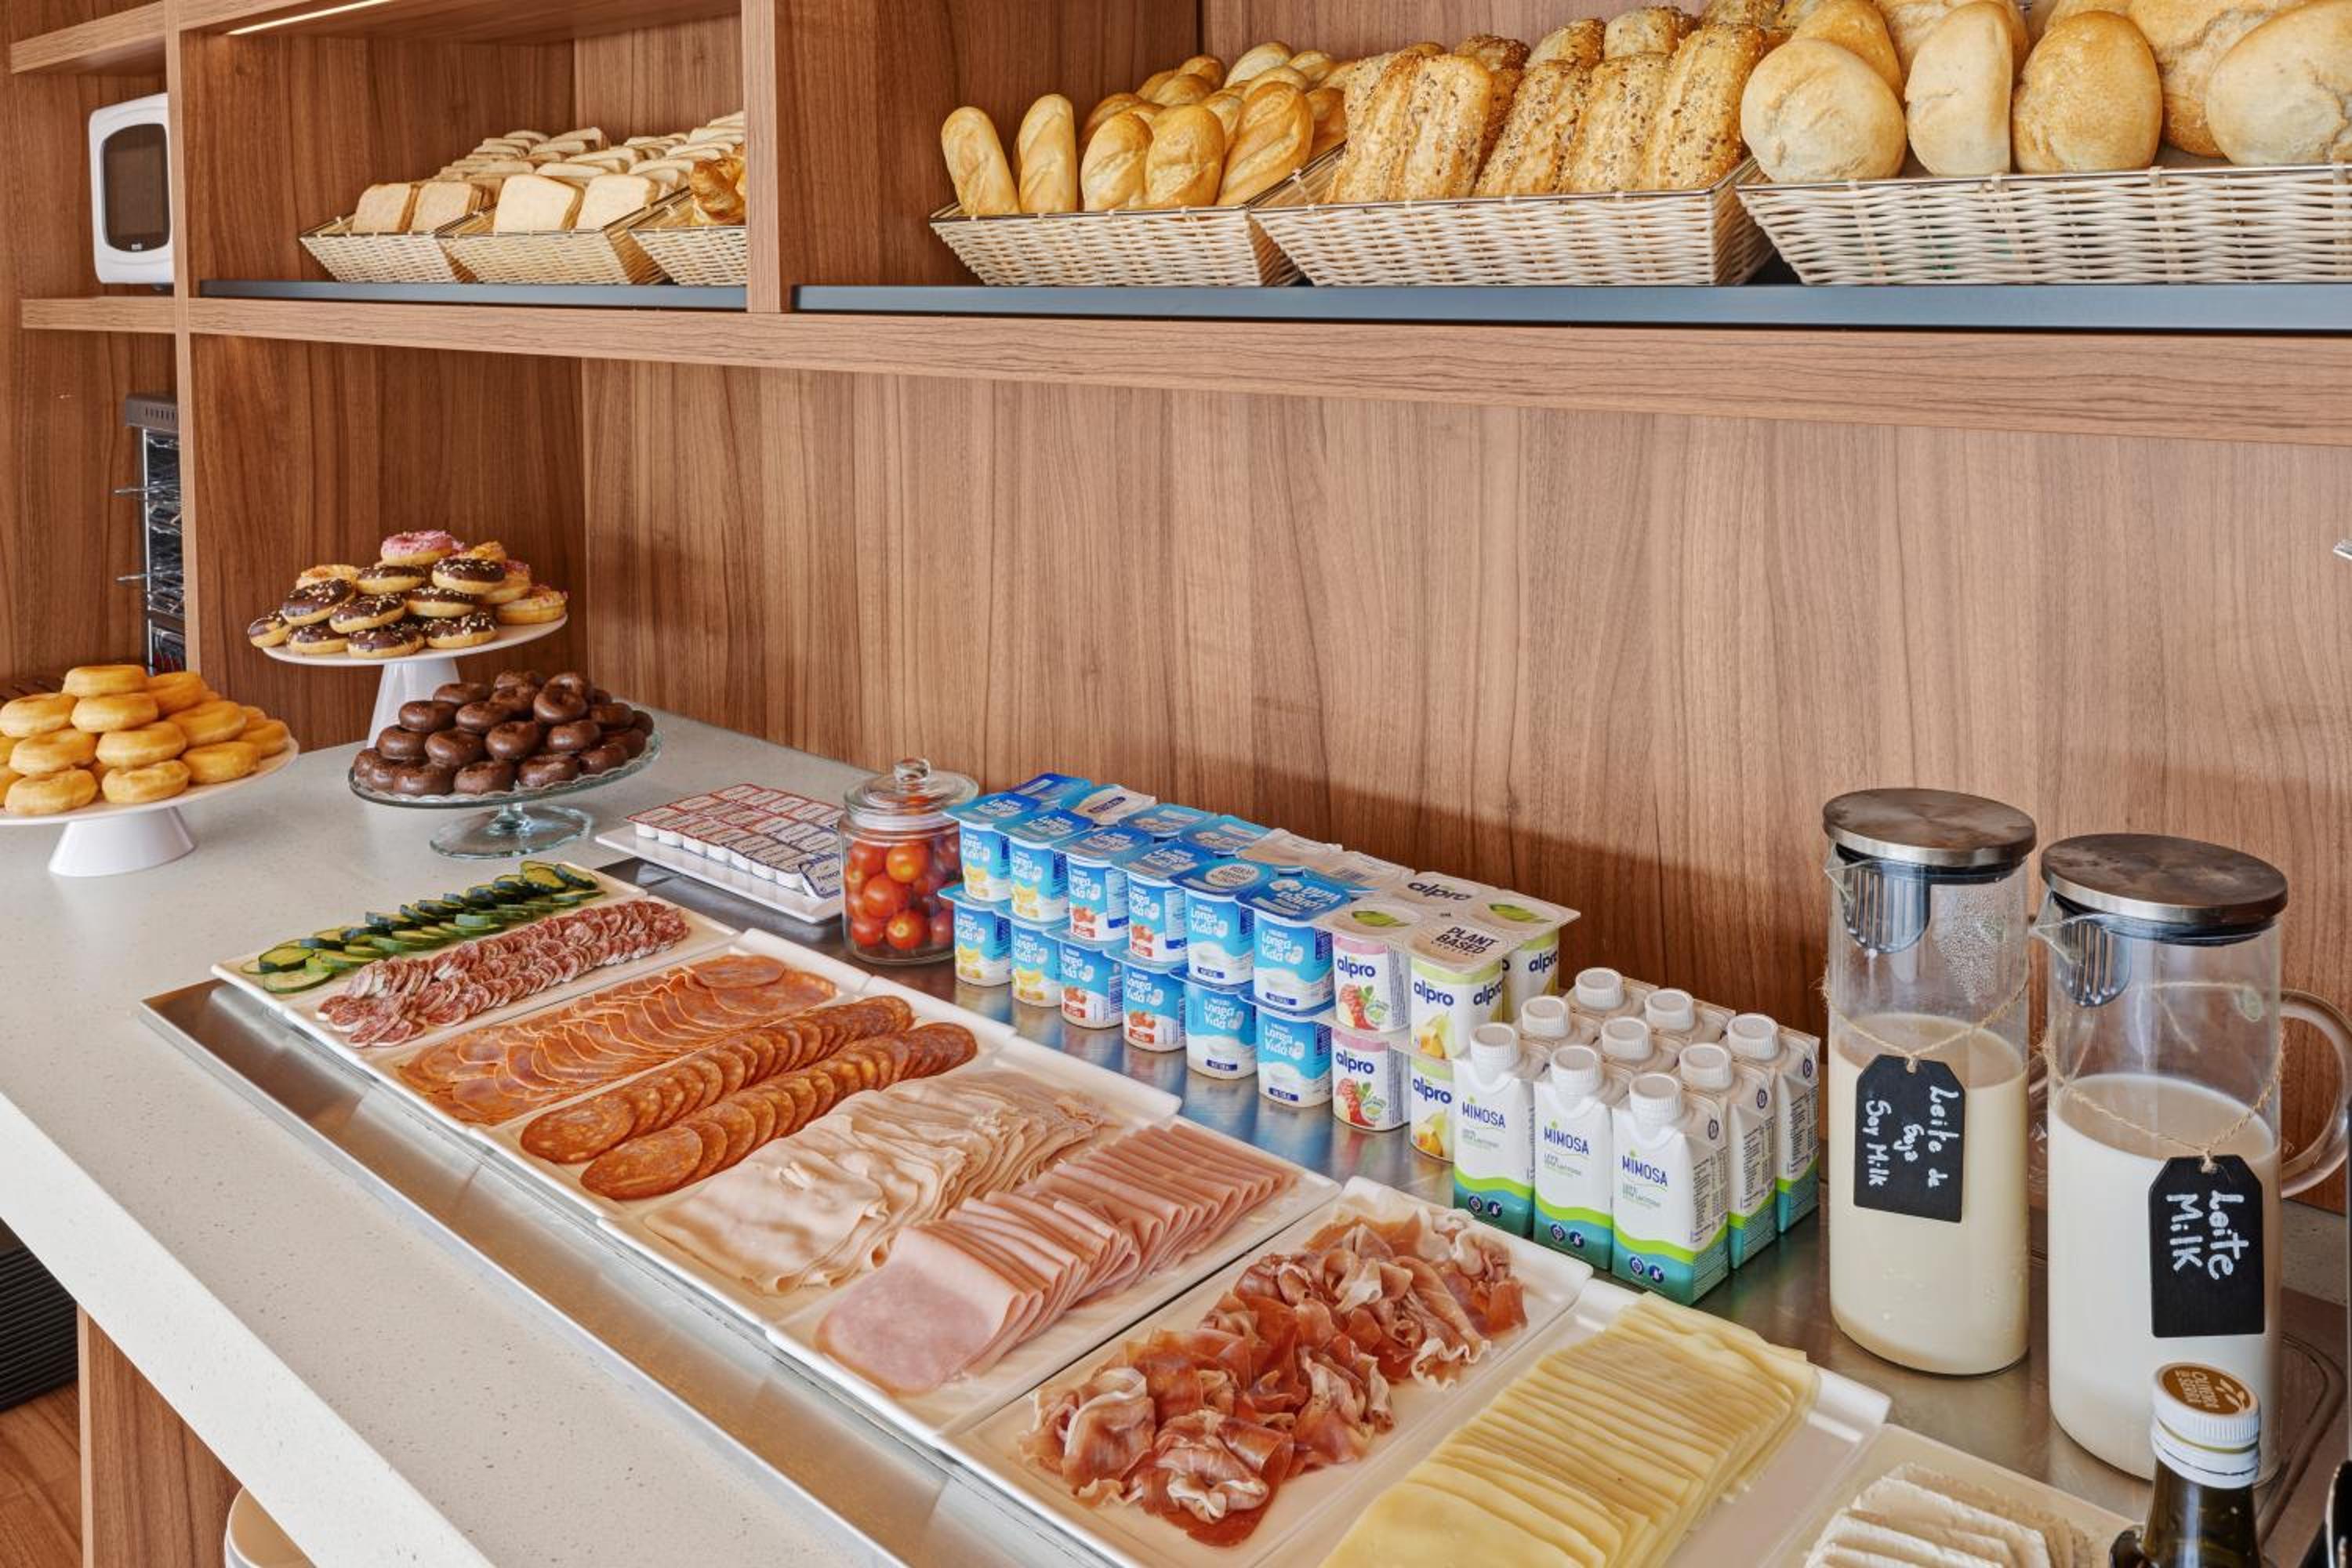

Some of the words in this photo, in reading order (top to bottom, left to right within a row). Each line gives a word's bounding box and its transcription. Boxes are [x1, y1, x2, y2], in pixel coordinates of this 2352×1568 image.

[1407, 882, 1472, 901] alpro
[1190, 907, 1218, 926] Longa
[1191, 919, 1213, 935] Vida
[1261, 931, 1292, 952] Longa
[1436, 934, 1487, 955] BASED
[1446, 926, 1499, 948] PLANT
[1261, 944, 1283, 963] Vida
[1337, 956, 1376, 978] alpro
[1414, 980, 1454, 1007] alpro
[1203, 1000, 1234, 1020] Longa
[1204, 1011, 1227, 1029] Vida
[1264, 1024, 1292, 1046] Longa
[1265, 1036, 1287, 1056] Vida
[1335, 1049, 1374, 1075] alpro
[1412, 1076, 1453, 1104] alpro
[1462, 1101, 1506, 1129] MIMOSA
[1862, 1099, 1893, 1137] Soy
[1927, 1085, 1960, 1153] Leite
[1544, 1126, 1589, 1155] MIMOSA
[1621, 1154, 1668, 1186] MIMOSA
[1865, 1142, 1890, 1186] Milk
[1928, 1167, 1949, 1189] de
[2165, 1192, 2205, 1272] Milk
[2207, 1189, 2249, 1281] Leite
